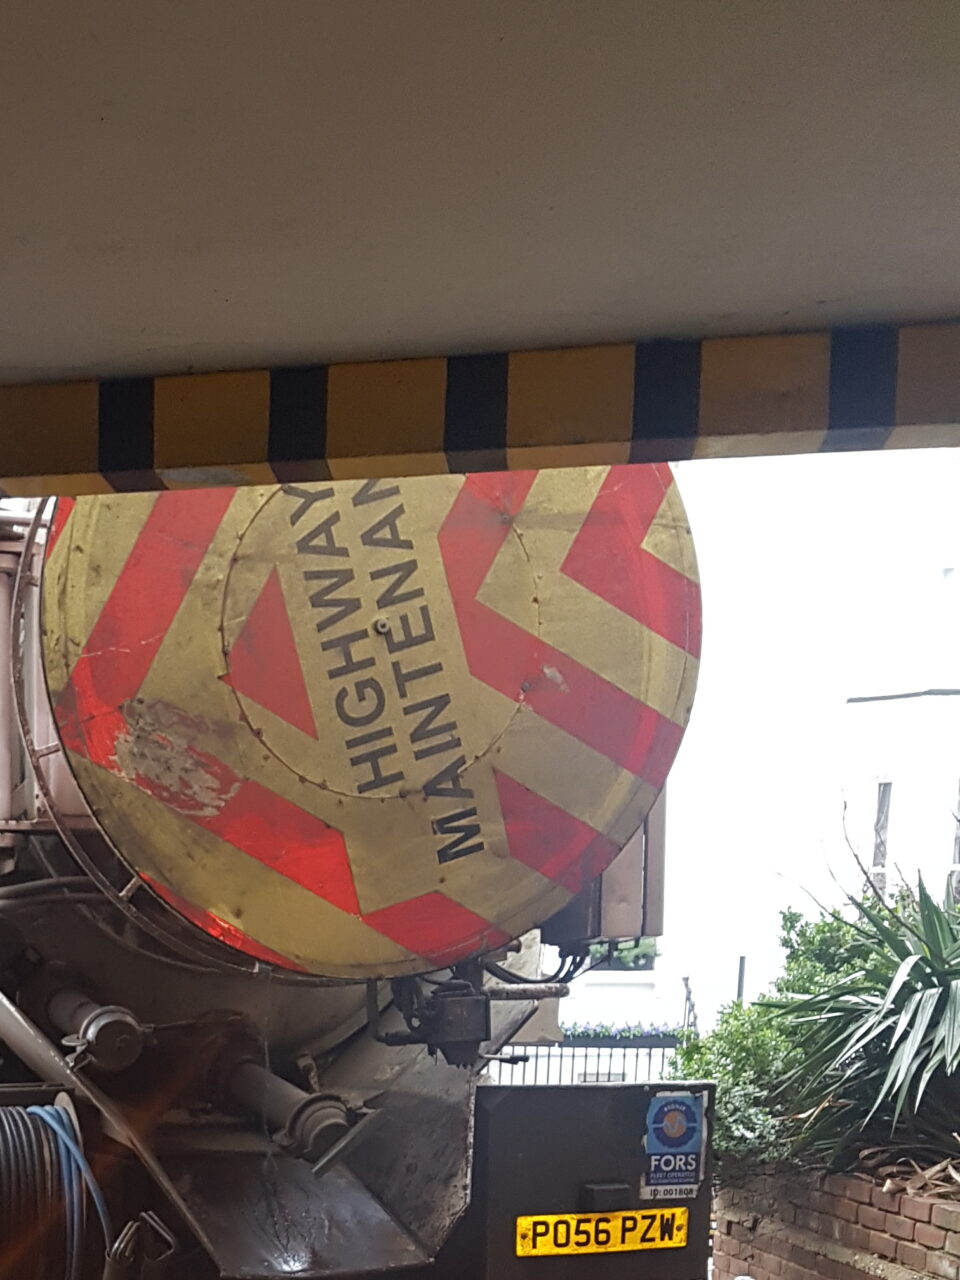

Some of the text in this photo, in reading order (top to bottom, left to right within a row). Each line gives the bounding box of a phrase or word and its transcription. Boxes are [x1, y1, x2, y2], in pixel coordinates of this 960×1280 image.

[282, 485, 405, 794] HIGHWAY
[650, 1154, 697, 1172] FORS
[532, 1213, 676, 1249] PO56 PZW
